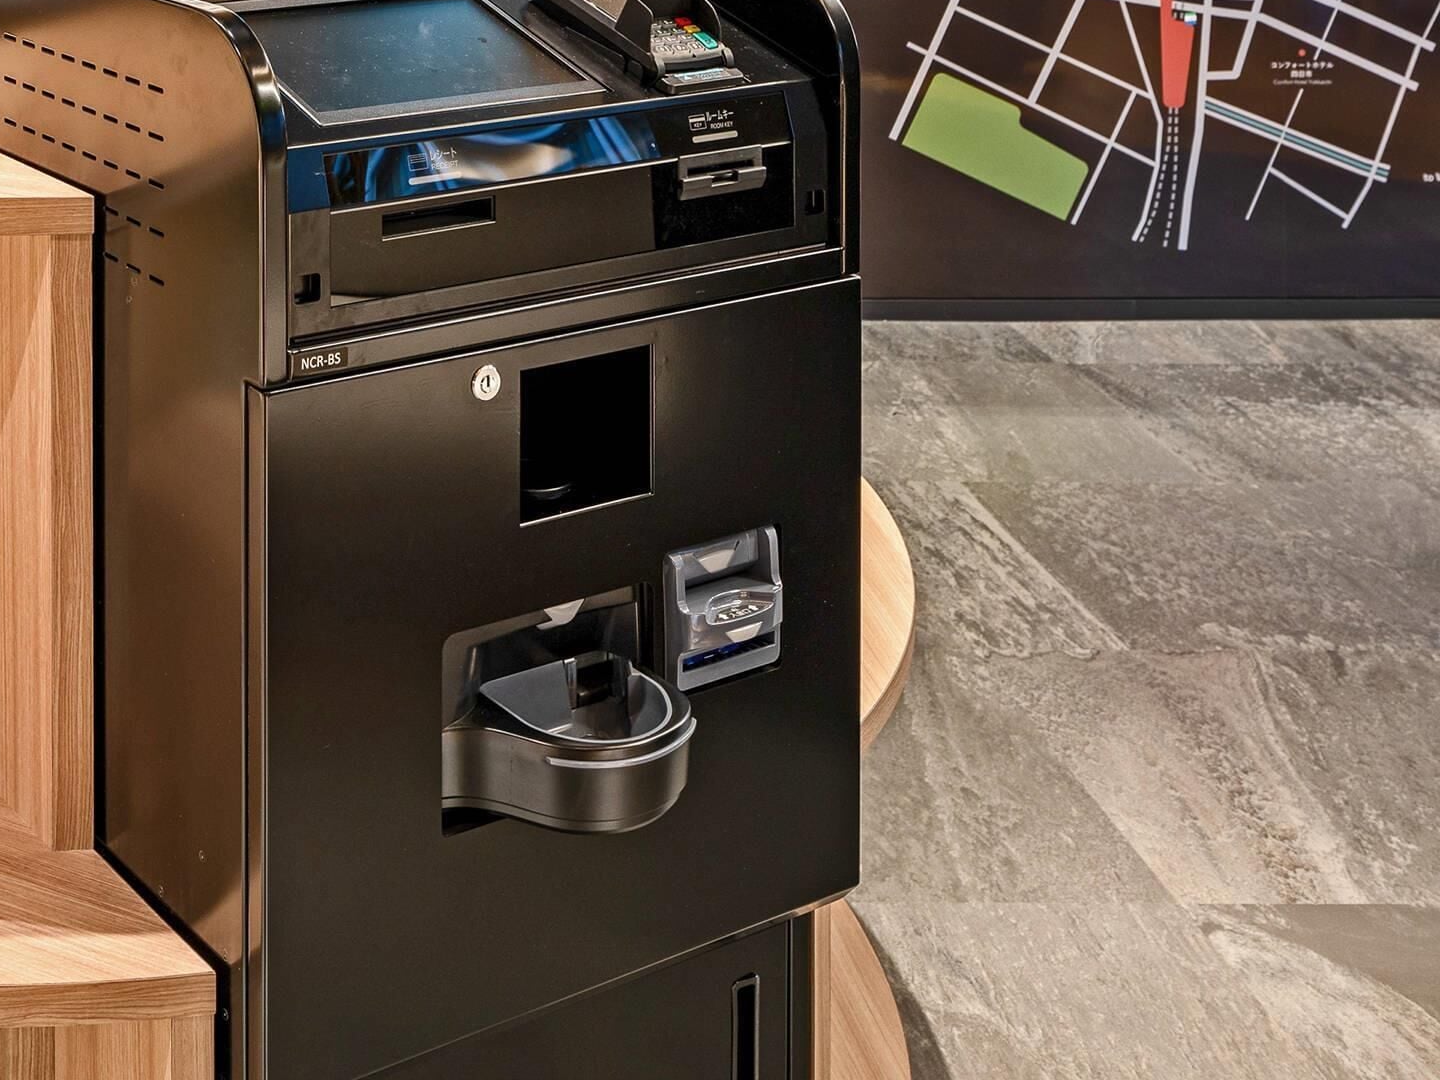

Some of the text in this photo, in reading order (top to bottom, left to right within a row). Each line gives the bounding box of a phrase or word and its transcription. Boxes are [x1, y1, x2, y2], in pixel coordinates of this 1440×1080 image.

[705, 109, 734, 122] ルームキー
[430, 146, 457, 161] レシート
[431, 160, 458, 171] RECEIPT
[301, 352, 341, 370] NCR-BS
